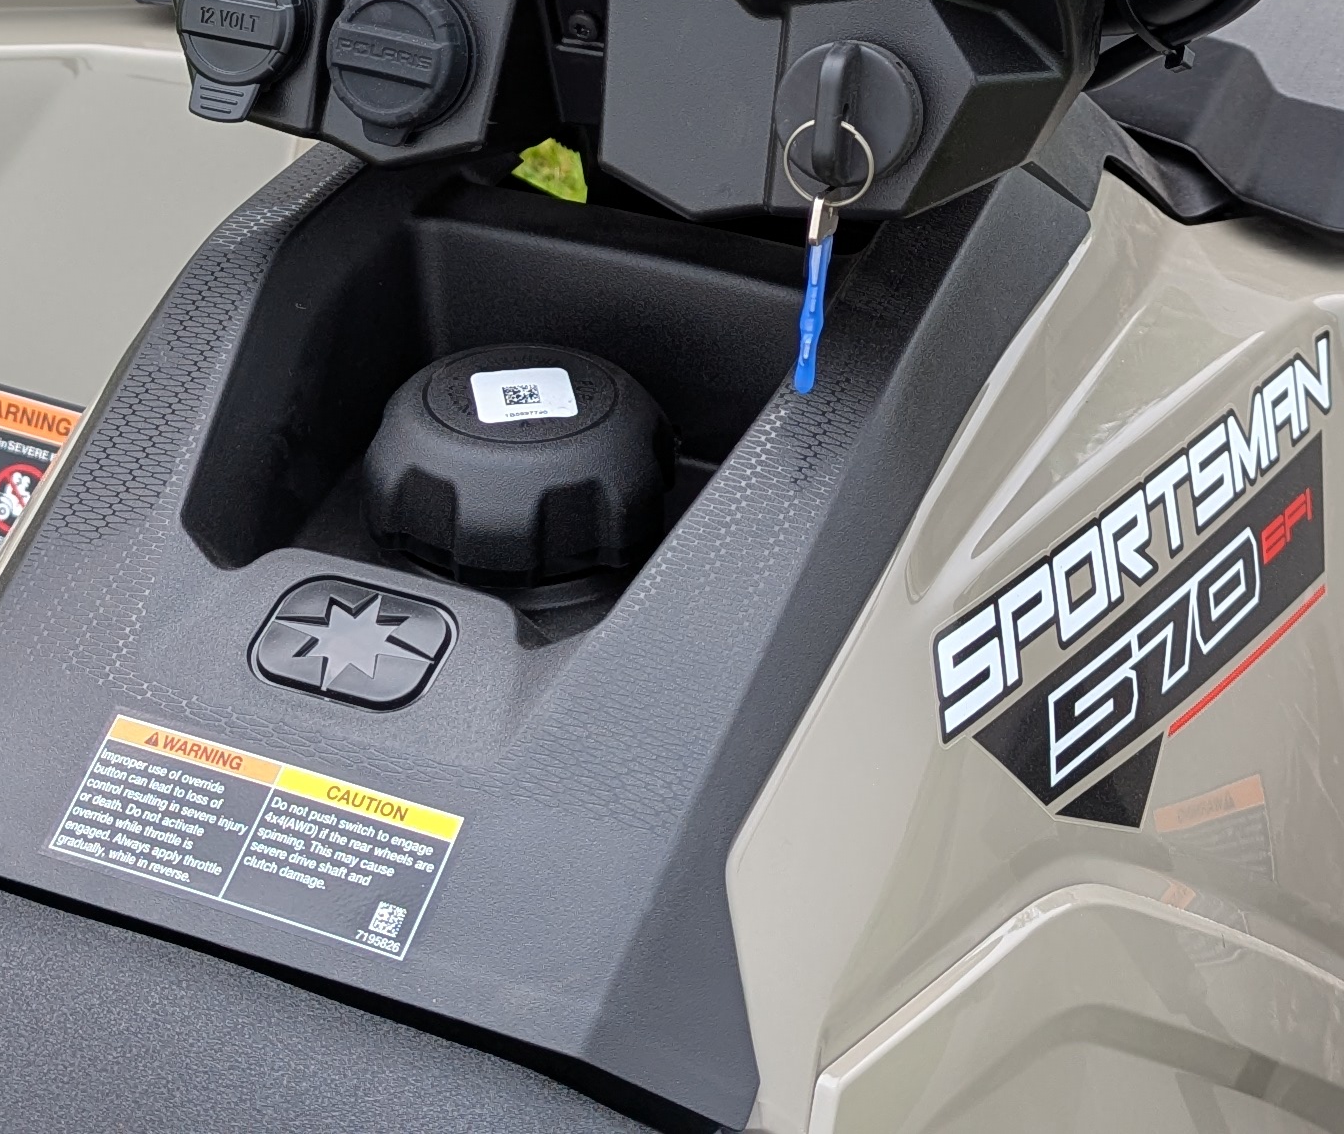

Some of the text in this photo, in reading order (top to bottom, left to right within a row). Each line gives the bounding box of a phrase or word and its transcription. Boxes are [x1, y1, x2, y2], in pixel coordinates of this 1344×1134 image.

[200, 6, 260, 33] 12 VOLT
[335, 36, 433, 70] POLARIS
[937, 336, 1330, 734] SPORTSMAN
[1261, 487, 1312, 565] EFI
[1048, 526, 1261, 787] 570
[100, 747, 225, 794] Improper use of override
[163, 735, 243, 771] WARNING
[86, 778, 249, 835] control resulting in severe injury
[93, 761, 224, 809] button can lead to loss of
[326, 785, 408, 821] CAUTION
[72, 806, 193, 849] override while throttle is
[79, 792, 204, 836] or death. Do not activate
[270, 796, 433, 856] Do not push switch to engage
[64, 820, 222, 875] engaged. Always apply throttle
[108, 849, 136, 865] while
[136, 856, 148, 869] in
[148, 862, 190, 882] reverse.
[249, 841, 372, 886] severe drive shaft and
[256, 827, 395, 877] spinning. This may cause
[318, 827, 329, 839] if
[328, 831, 347, 845] the
[348, 839, 373, 853] rear
[373, 846, 413, 866] wheels
[414, 860, 434, 873] are
[243, 855, 325, 889] clutch damage.
